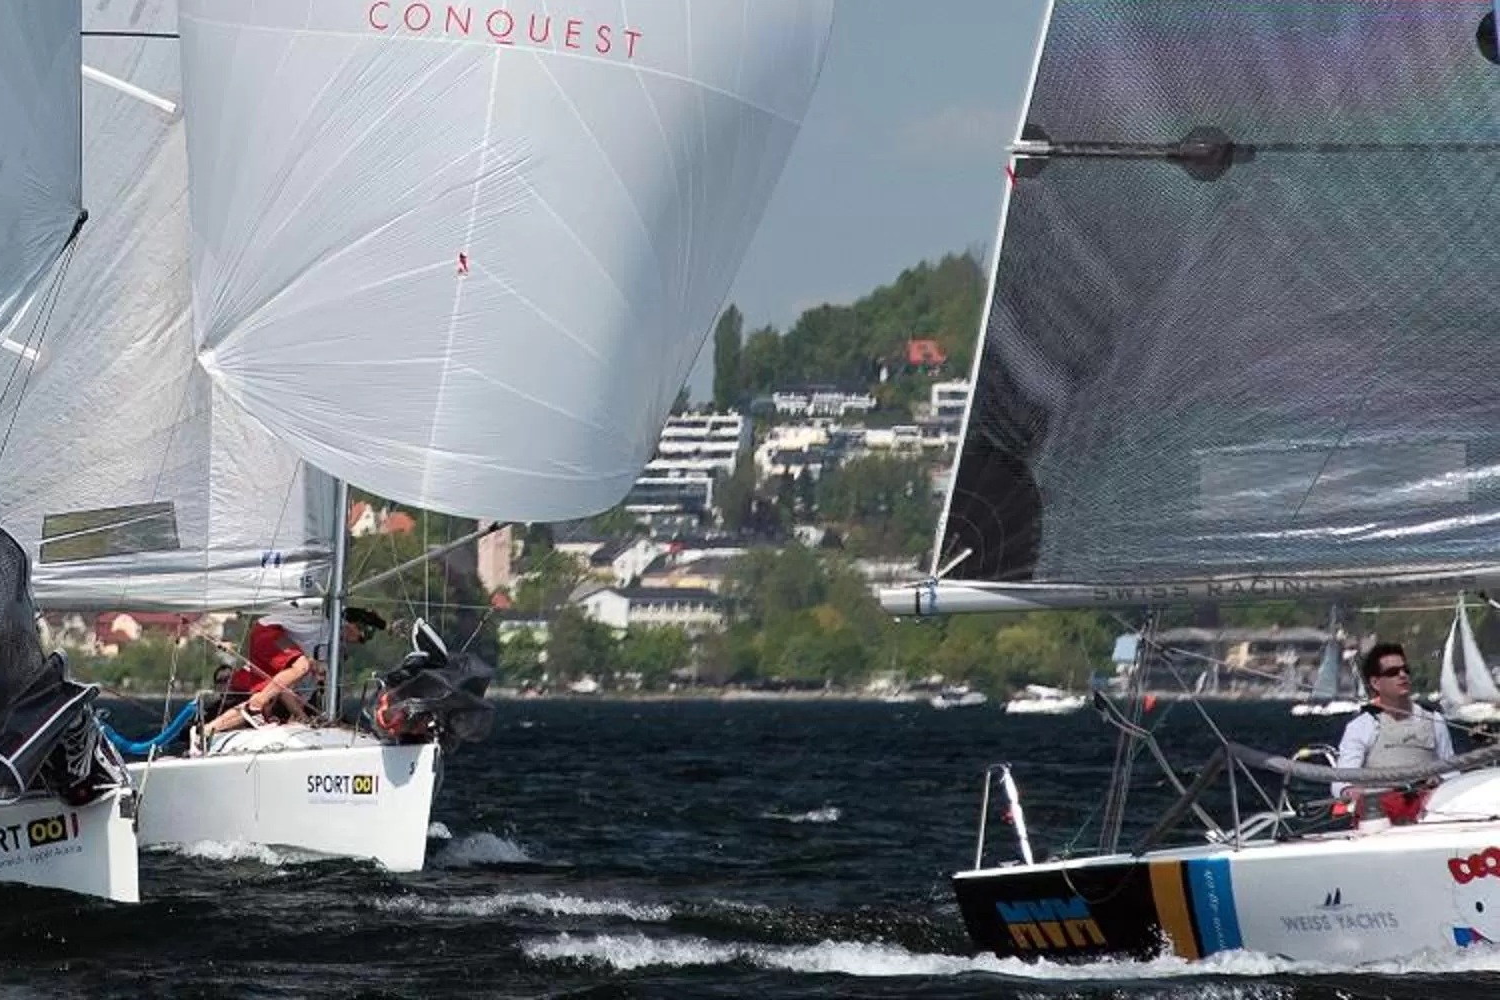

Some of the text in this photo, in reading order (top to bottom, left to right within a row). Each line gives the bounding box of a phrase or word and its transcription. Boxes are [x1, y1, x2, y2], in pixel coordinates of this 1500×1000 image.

[368, 1, 644, 58] CONQUEST
[307, 775, 350, 793] SPORT
[1280, 911, 1400, 933] WEISS YACHTS
